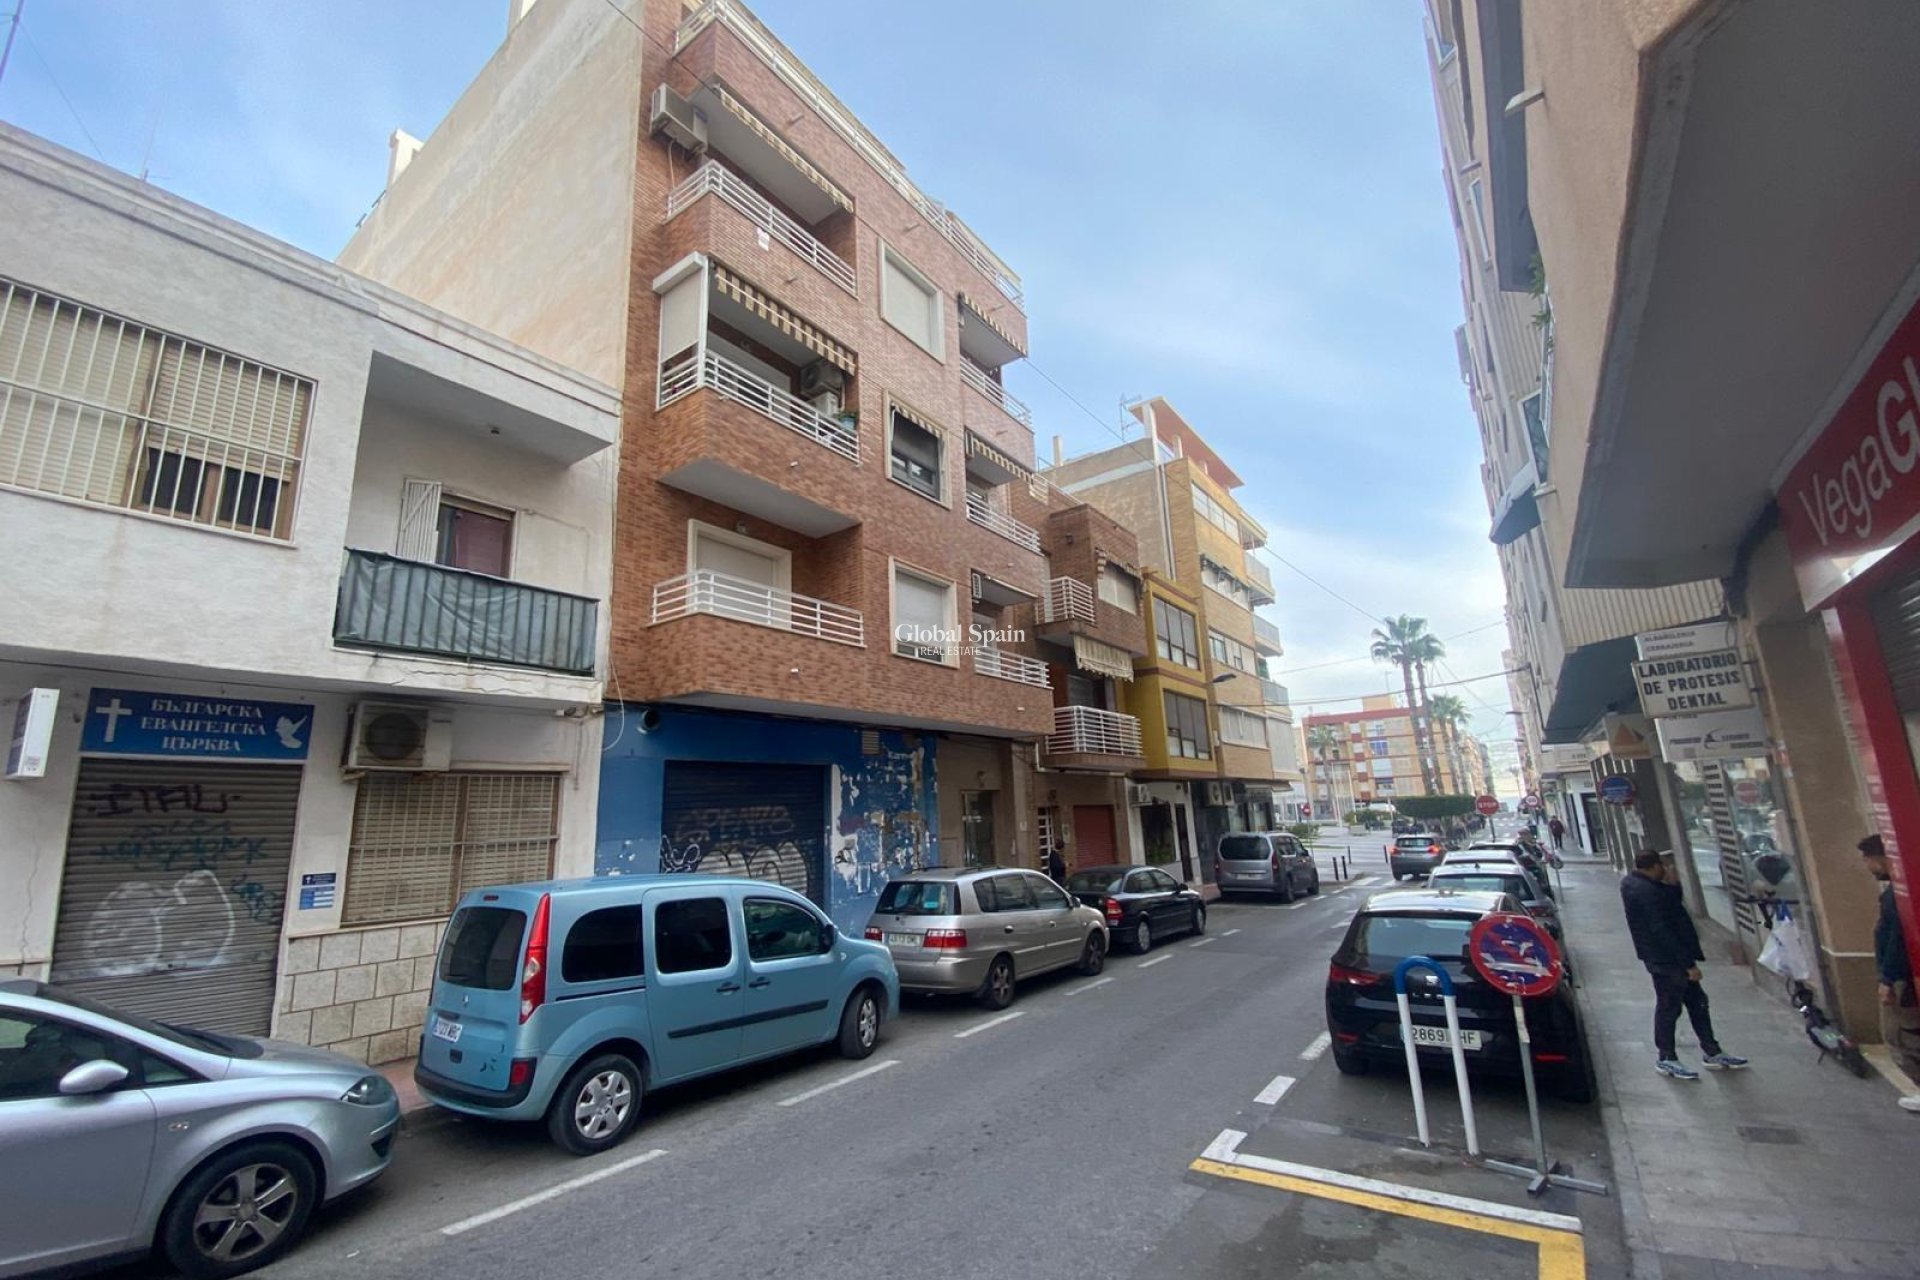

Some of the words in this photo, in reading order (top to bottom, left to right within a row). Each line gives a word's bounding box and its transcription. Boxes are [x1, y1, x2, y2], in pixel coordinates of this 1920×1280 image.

[1799, 356, 1920, 546] VegaG
[1638, 652, 1738, 678] LABORATORIO
[1643, 680, 1662, 696] DE
[1668, 670, 1741, 693] PROTESIS
[151, 698, 264, 719] БЪЛГАРСКА
[1667, 691, 1727, 711] DENTAL
[140, 716, 267, 736] ЕВАНГЕЛСКА
[162, 735, 242, 752] ЦЪРКВА
[1478, 801, 1498, 809] STOP
[1412, 1028, 1445, 1042] 2869
